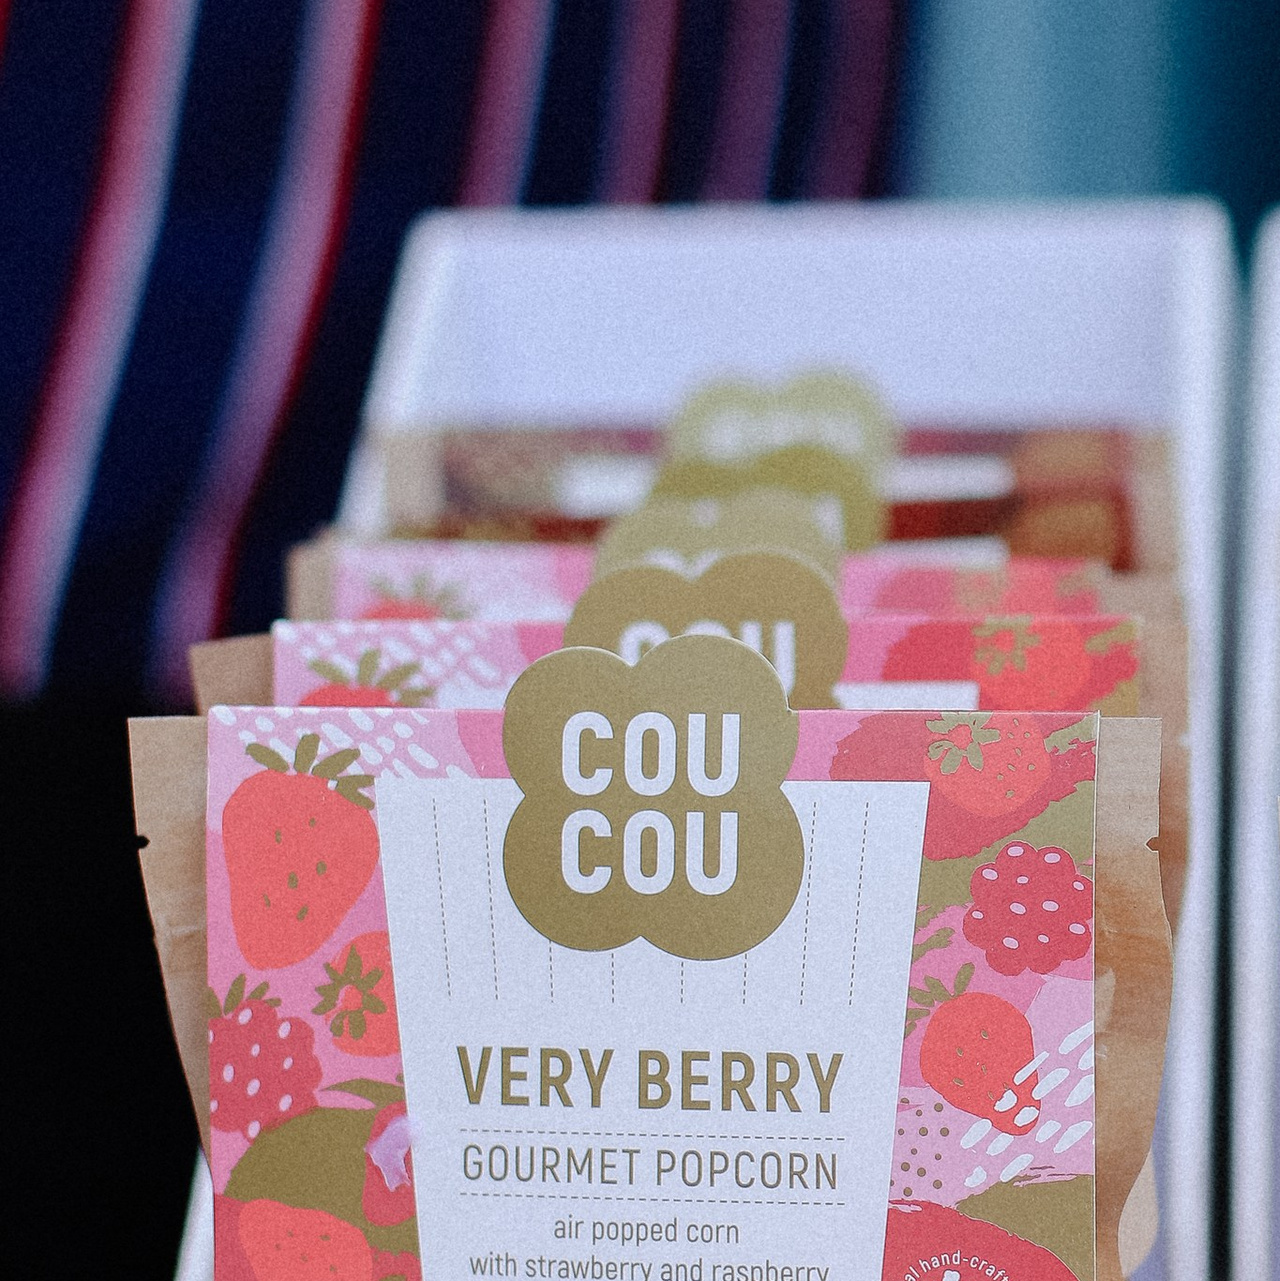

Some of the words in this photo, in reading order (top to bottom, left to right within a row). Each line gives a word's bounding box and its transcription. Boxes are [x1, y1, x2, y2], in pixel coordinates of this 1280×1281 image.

[562, 711, 740, 797] COU
[561, 809, 739, 895] COU
[456, 1046, 614, 1108] VERY
[638, 1049, 843, 1113] BERRY
[463, 1144, 640, 1186] GOURMET
[656, 1149, 838, 1190] POPCORN
[553, 1214, 584, 1240] air
[592, 1217, 678, 1246] popped
[686, 1222, 740, 1244] corn
[469, 1252, 517, 1278] with
